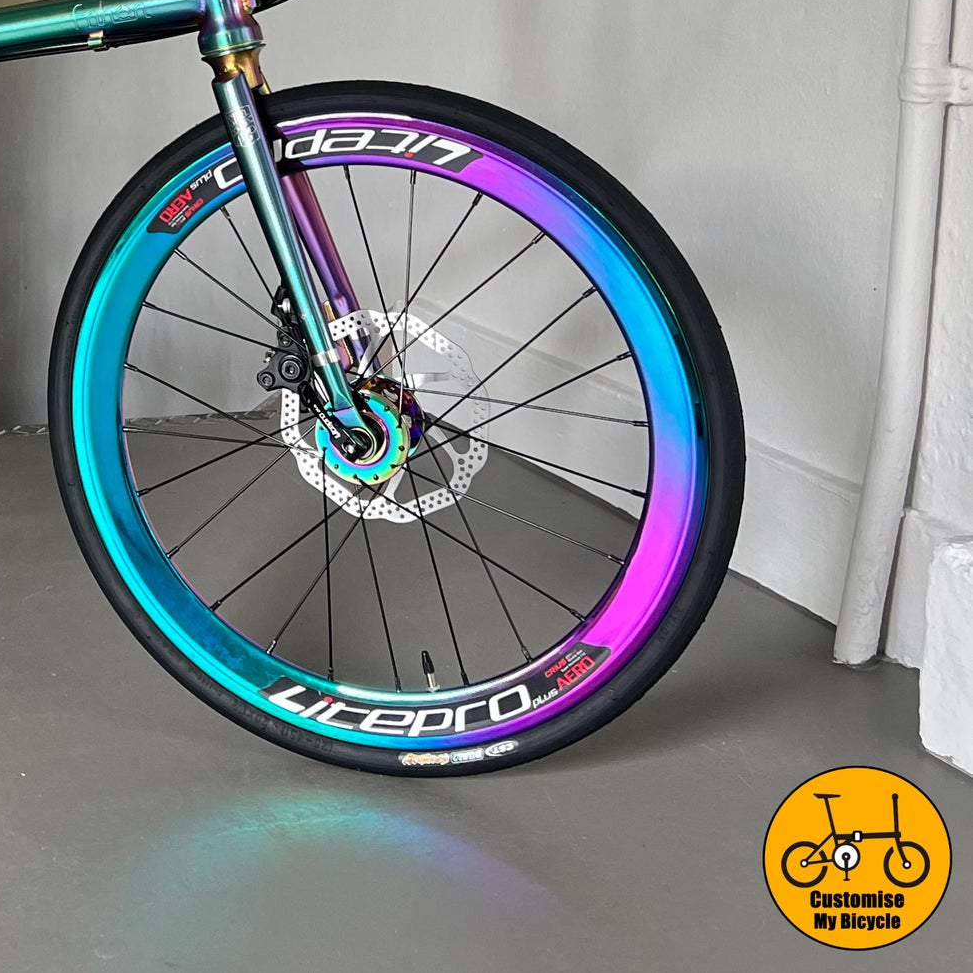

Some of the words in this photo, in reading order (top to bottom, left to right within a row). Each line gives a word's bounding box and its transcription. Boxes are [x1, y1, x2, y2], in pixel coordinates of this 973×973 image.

[189, 169, 213, 191] plus
[158, 188, 193, 224] AERO
[267, 683, 532, 738] Litepro
[532, 687, 560, 709] plus
[556, 655, 597, 691] AERO
